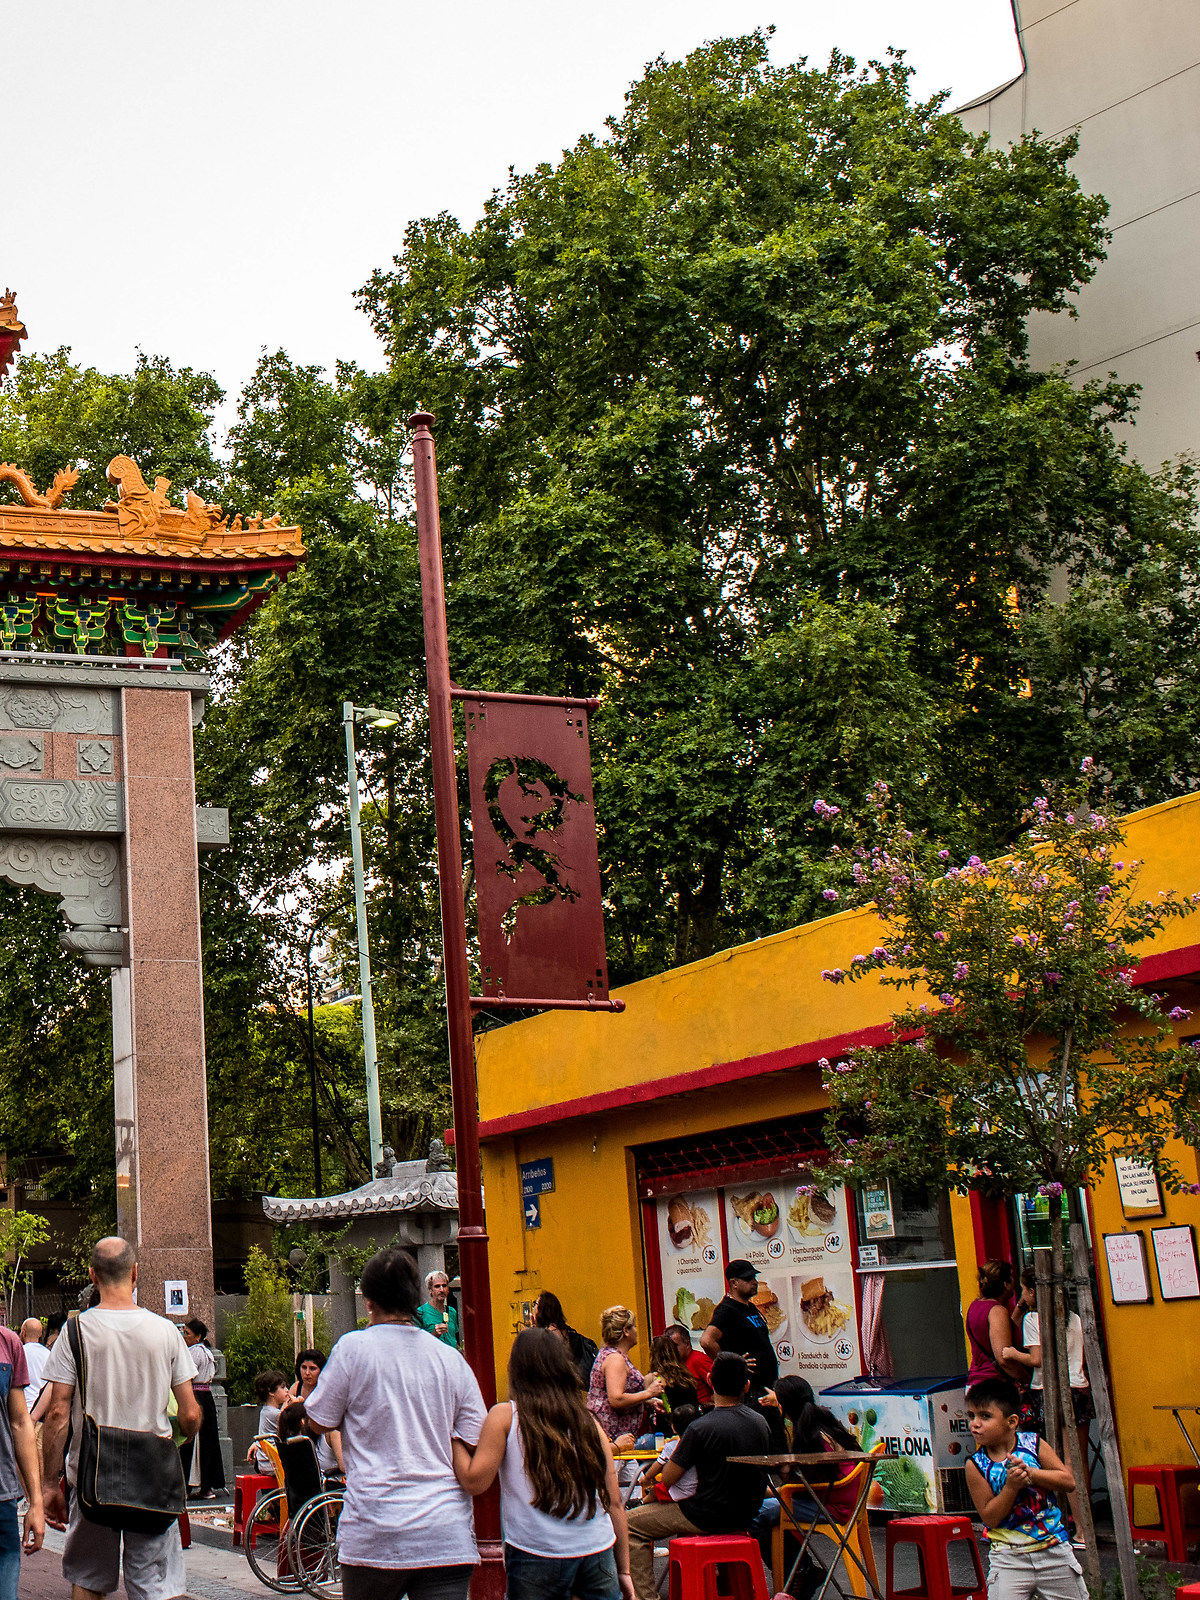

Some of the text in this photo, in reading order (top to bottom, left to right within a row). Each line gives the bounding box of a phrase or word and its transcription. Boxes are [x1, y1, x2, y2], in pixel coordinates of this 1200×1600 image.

[827, 1235, 840, 1247] $42
[769, 1242, 781, 1254] $60
[793, 1246, 825, 1255] Hamburguesa
[704, 1249, 716, 1260] $38
[778, 1345, 791, 1356] $48
[836, 1343, 850, 1355] $65
[801, 1352, 823, 1360] Sandwich
[798, 1362, 819, 1370] Bondiola
[880, 1436, 933, 1457] MELONA
